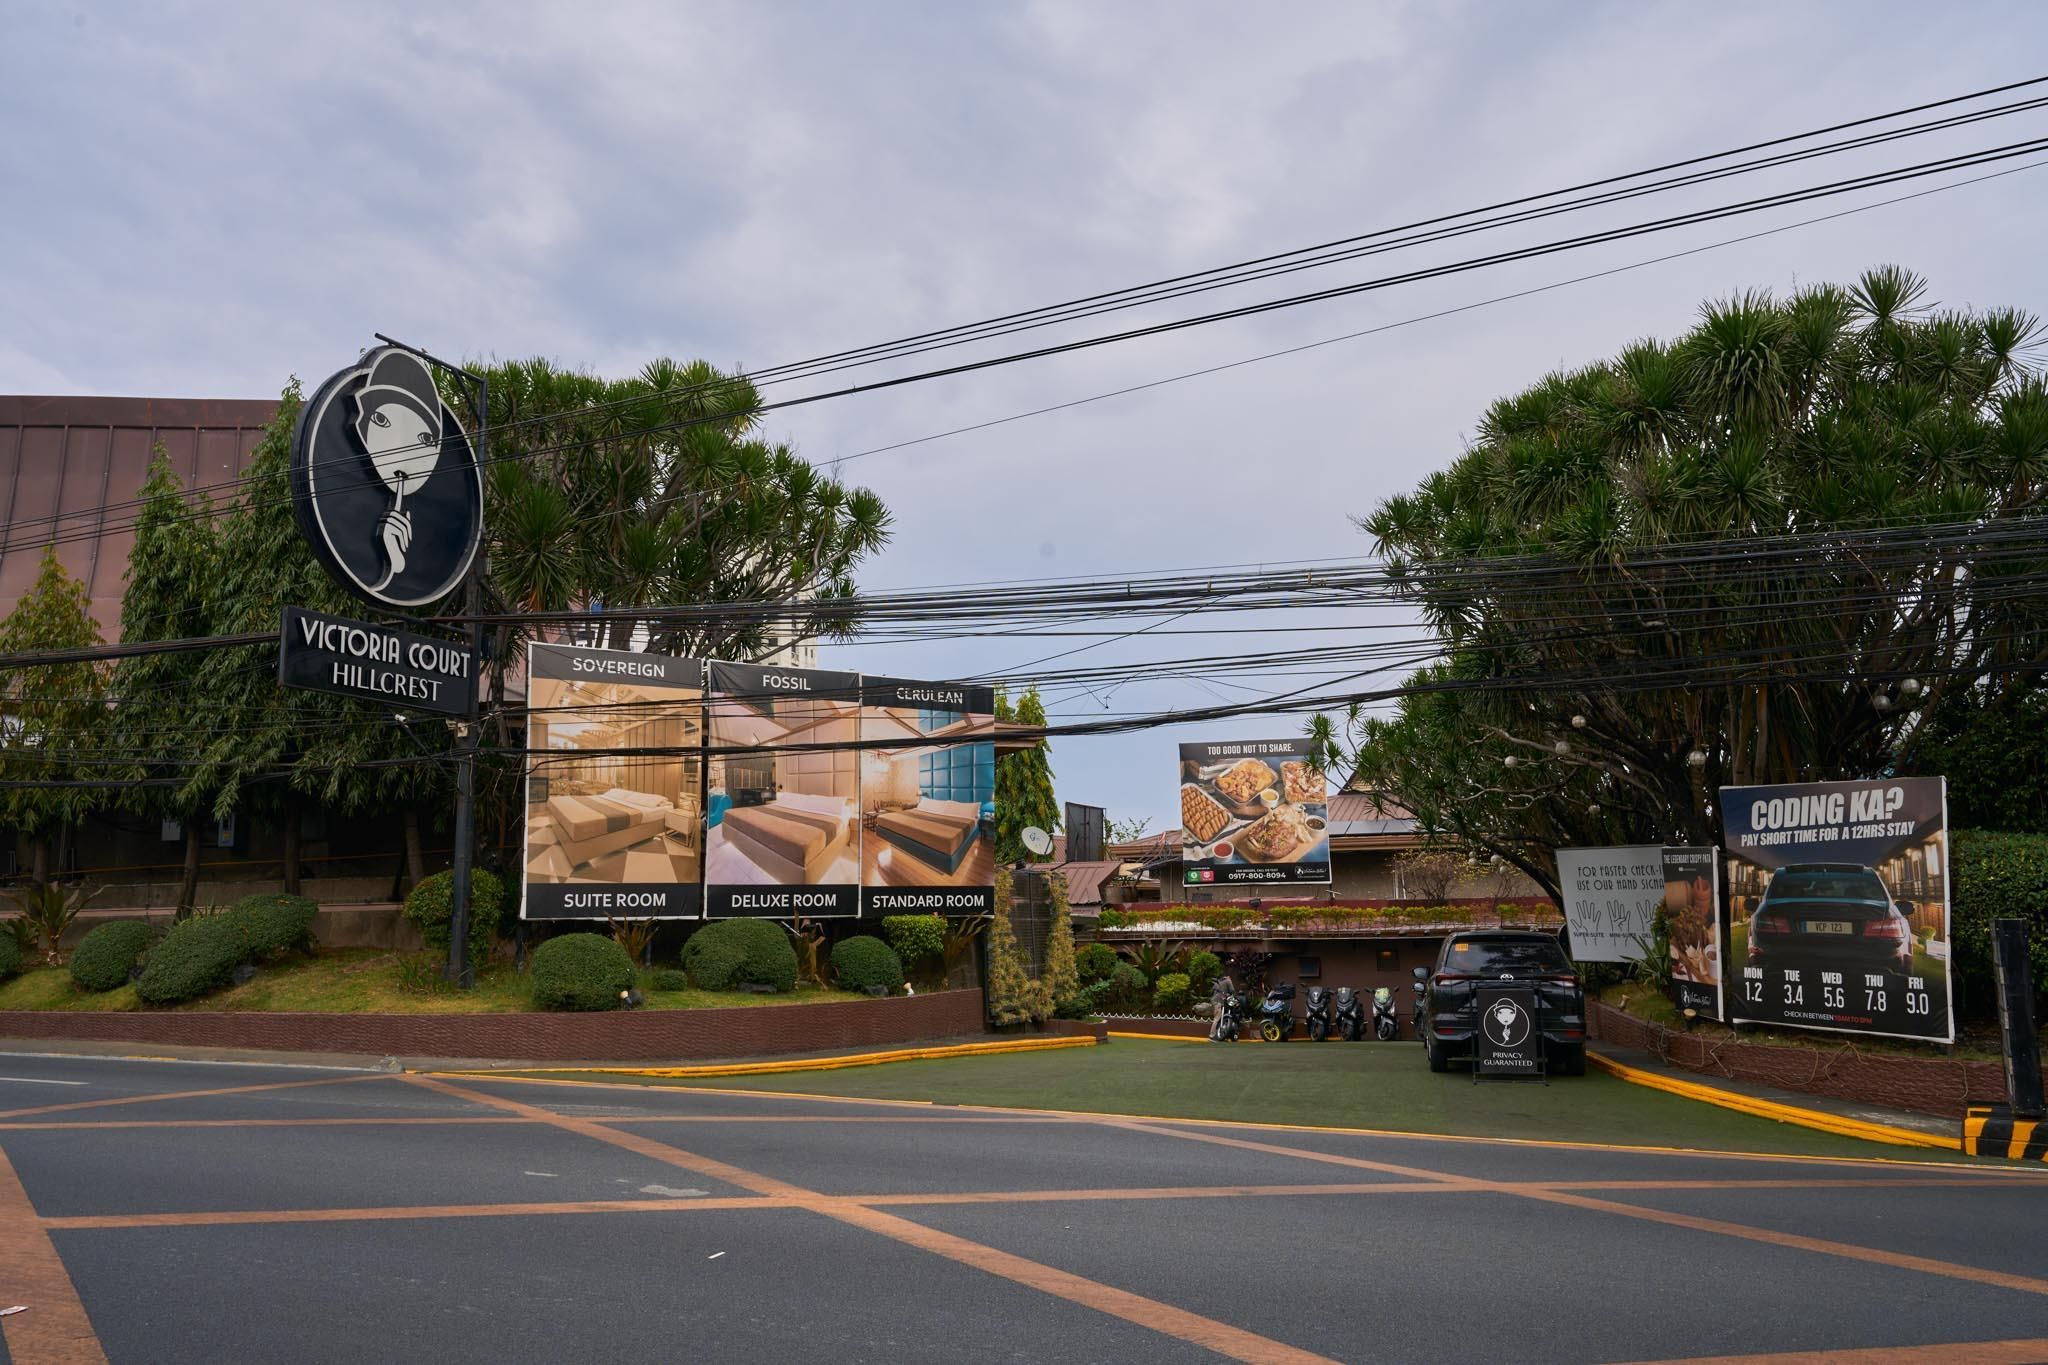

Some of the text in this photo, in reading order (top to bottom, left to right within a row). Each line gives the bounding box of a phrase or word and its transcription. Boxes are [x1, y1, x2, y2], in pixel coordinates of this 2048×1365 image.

[301, 617, 471, 678] VICTORIA COURT
[573, 658, 665, 678] SOVEREIGN
[333, 662, 442, 701] HILLCREST
[762, 675, 811, 691] FOSSIL
[897, 687, 963, 704] CERULEAN
[1208, 743, 1295, 755] TOO GOOD NOT TO SHARE.
[1751, 786, 1904, 831] CODING KA?
[1741, 821, 1915, 847] PAY SHORT TIME FOR A 12HRS STAY
[1228, 872, 1287, 880] 0917-800-8094
[1578, 864, 1663, 877] FOR FASTER CHECK-I
[1576, 878, 1664, 890] USE OUR HAND SIGNA
[564, 893, 667, 908] SUITE ROOM
[732, 894, 837, 908] DELUXE ROOM
[873, 895, 985, 908] STANDARD ROOM
[1744, 967, 1763, 979] MON
[1784, 970, 1800, 982] TUE
[1821, 972, 1842, 984] WED
[1865, 974, 1883, 987] THU
[1908, 976, 1923, 989] FRI
[1745, 981, 1763, 1002] 1.2
[1784, 984, 1803, 1005] 3.4
[1824, 987, 1844, 1008] 5.6
[1865, 990, 1887, 1012] 7.8
[1906, 993, 1929, 1015] 9.0
[1784, 1010, 1802, 1018] CHECK
[1808, 1012, 1834, 1020] BETWEEN
[1492, 1051, 1523, 1059] PRIVACY
[1483, 1059, 1533, 1067] GUARANTEED
